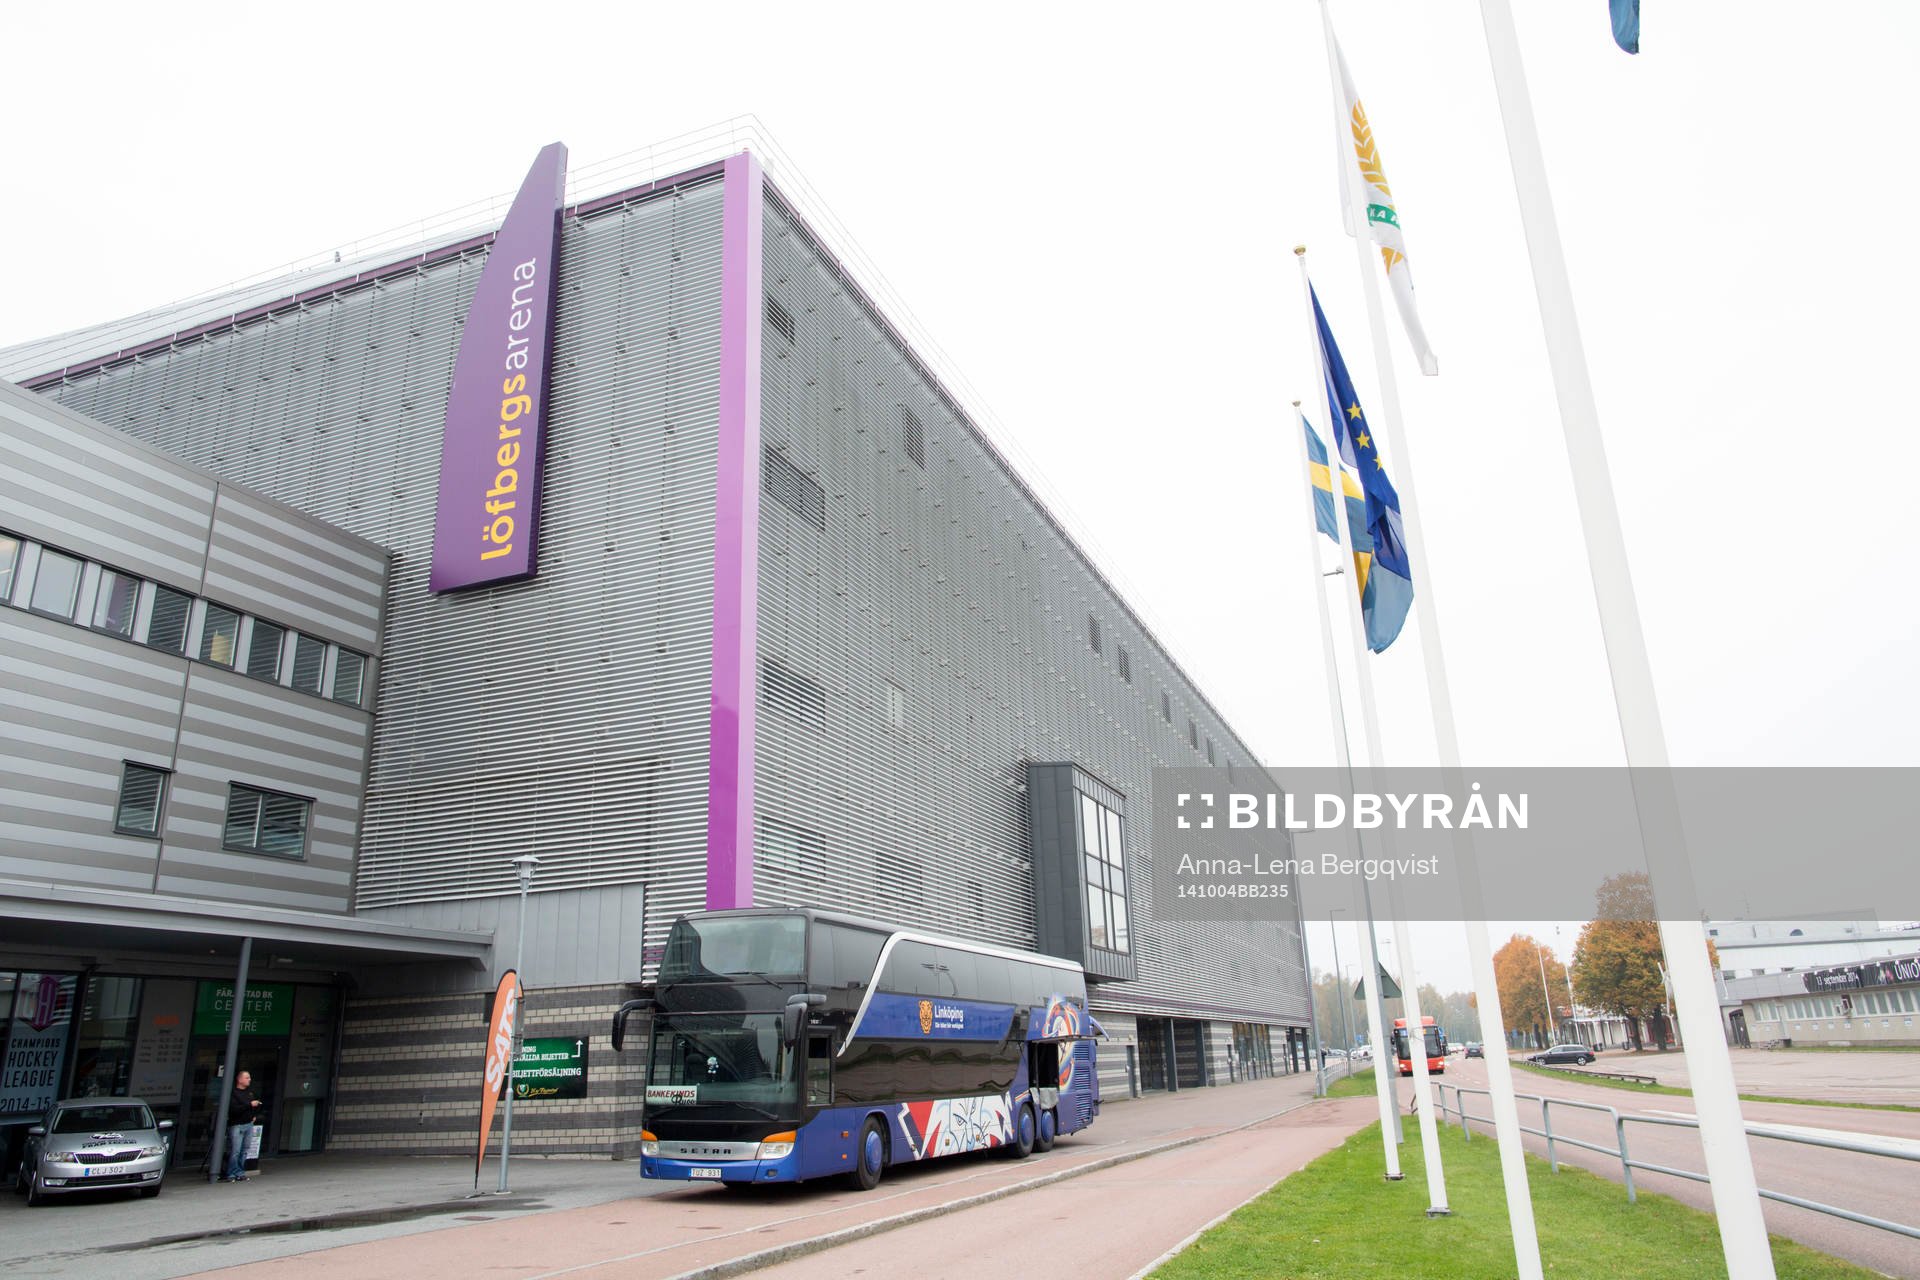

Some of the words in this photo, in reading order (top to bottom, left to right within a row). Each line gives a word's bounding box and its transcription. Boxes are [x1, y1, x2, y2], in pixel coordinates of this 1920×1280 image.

[1823, 973, 1847, 985] september
[214, 999, 272, 1012] CETER
[934, 1005, 964, 1023] Linköping
[225, 1017, 257, 1032] ETRÉ
[11, 1038, 61, 1049] CHAMPIONS
[7, 1050, 59, 1068] HOCKEY
[4, 1069, 56, 1088] LEAGUE
[0, 1096, 51, 1112] 2014-15
